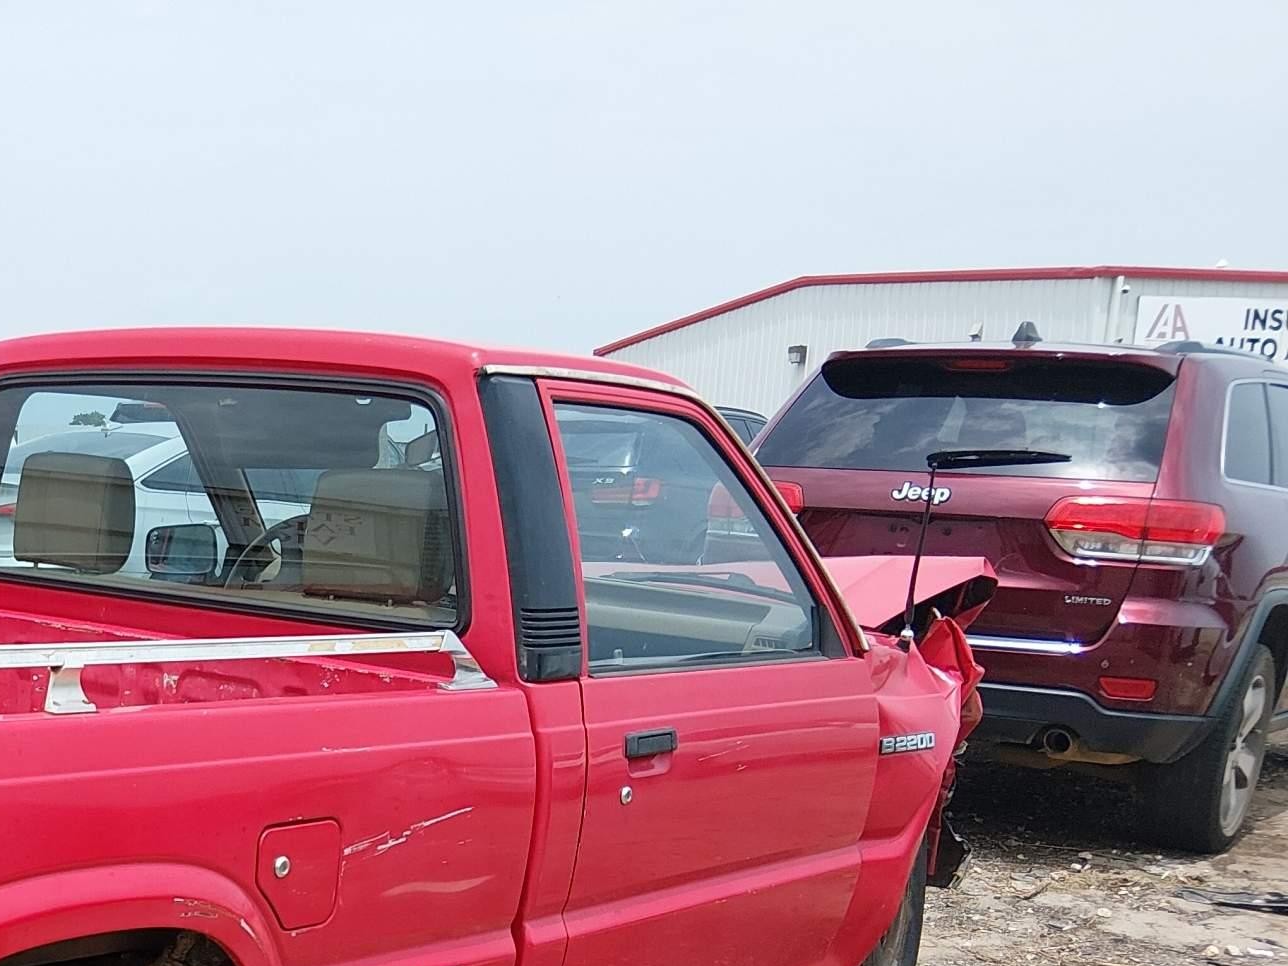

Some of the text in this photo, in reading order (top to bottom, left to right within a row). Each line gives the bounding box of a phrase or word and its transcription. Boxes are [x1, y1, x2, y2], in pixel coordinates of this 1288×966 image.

[1243, 307, 1288, 332] INS
[891, 481, 952, 506] Jeep
[1064, 595, 1113, 606] LIMITED
[880, 732, 936, 754] B2200
